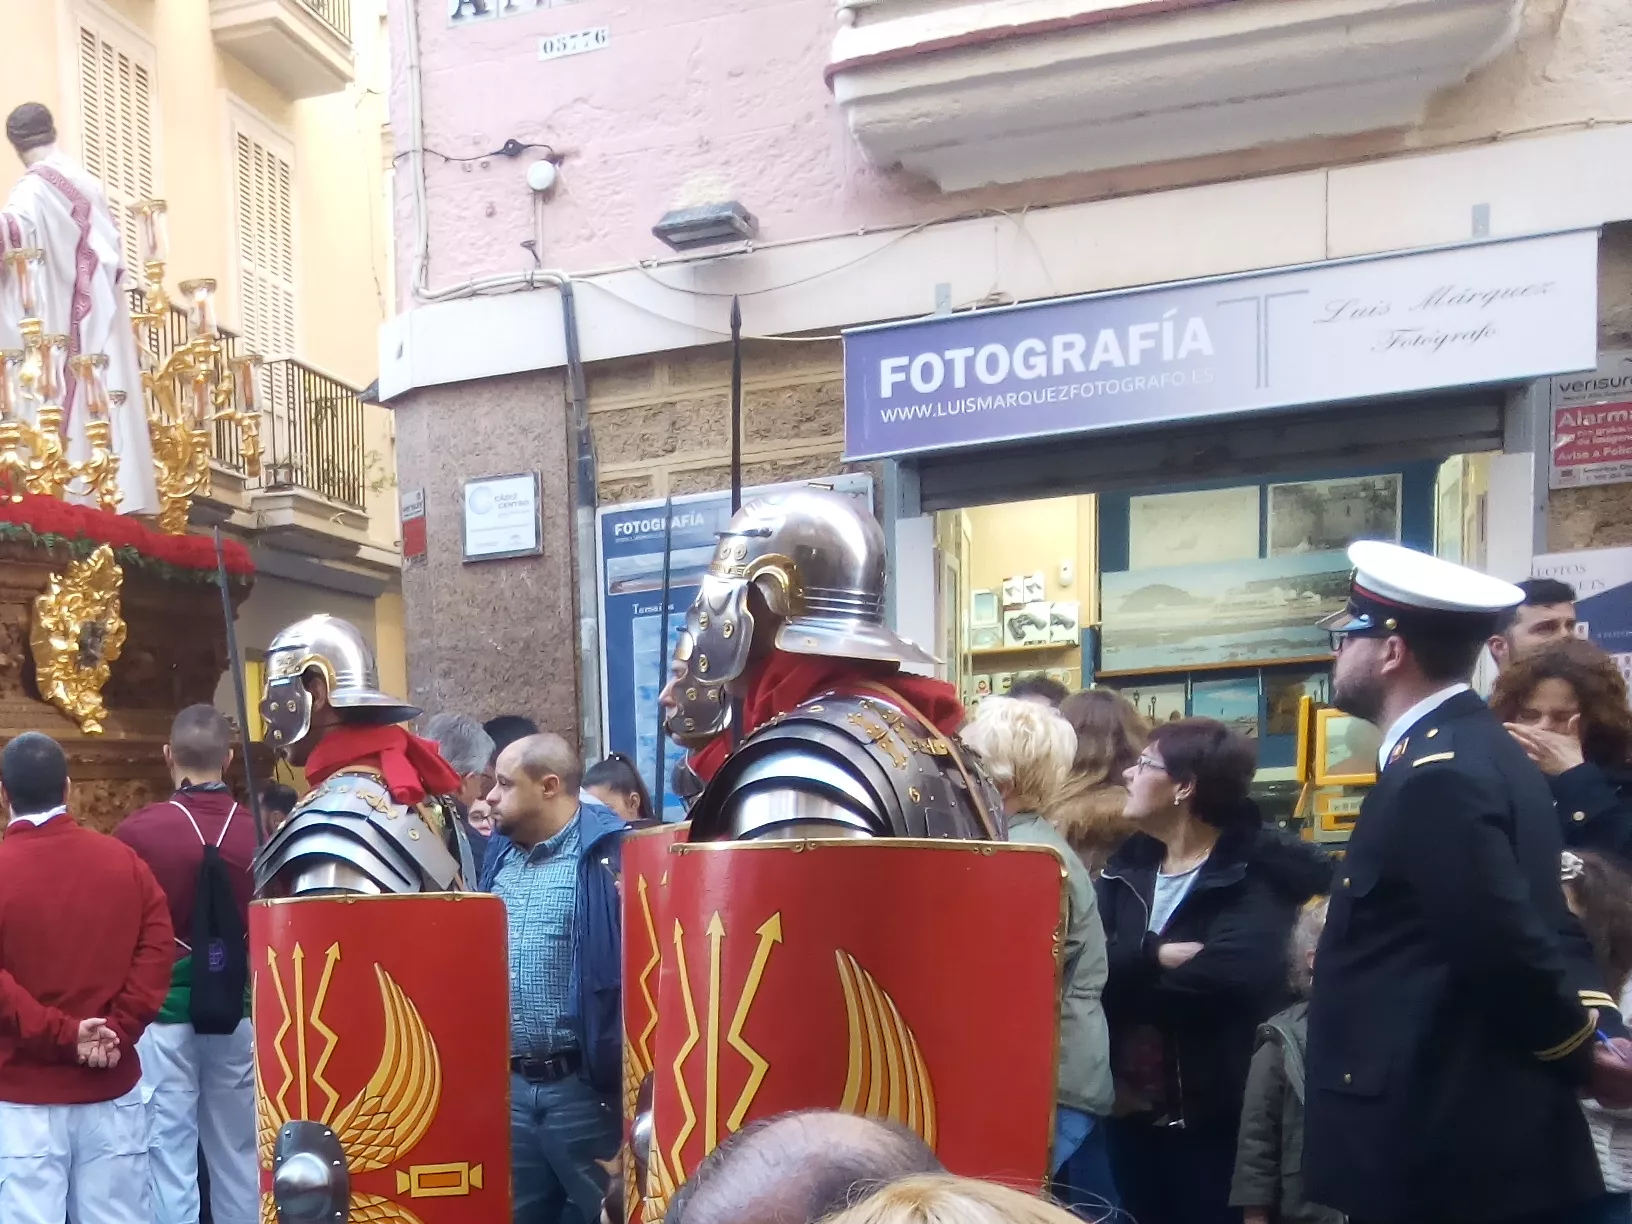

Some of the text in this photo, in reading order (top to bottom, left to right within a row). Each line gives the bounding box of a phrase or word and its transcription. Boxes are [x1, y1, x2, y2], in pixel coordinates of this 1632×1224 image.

[542, 29, 606, 54] 05776
[879, 307, 1215, 399] FOTOGRAFÍA
[879, 366, 1215, 424] WWW.LUISMARQUEZFOTOGRAFO.ES
[1557, 408, 1632, 428] Alarm
